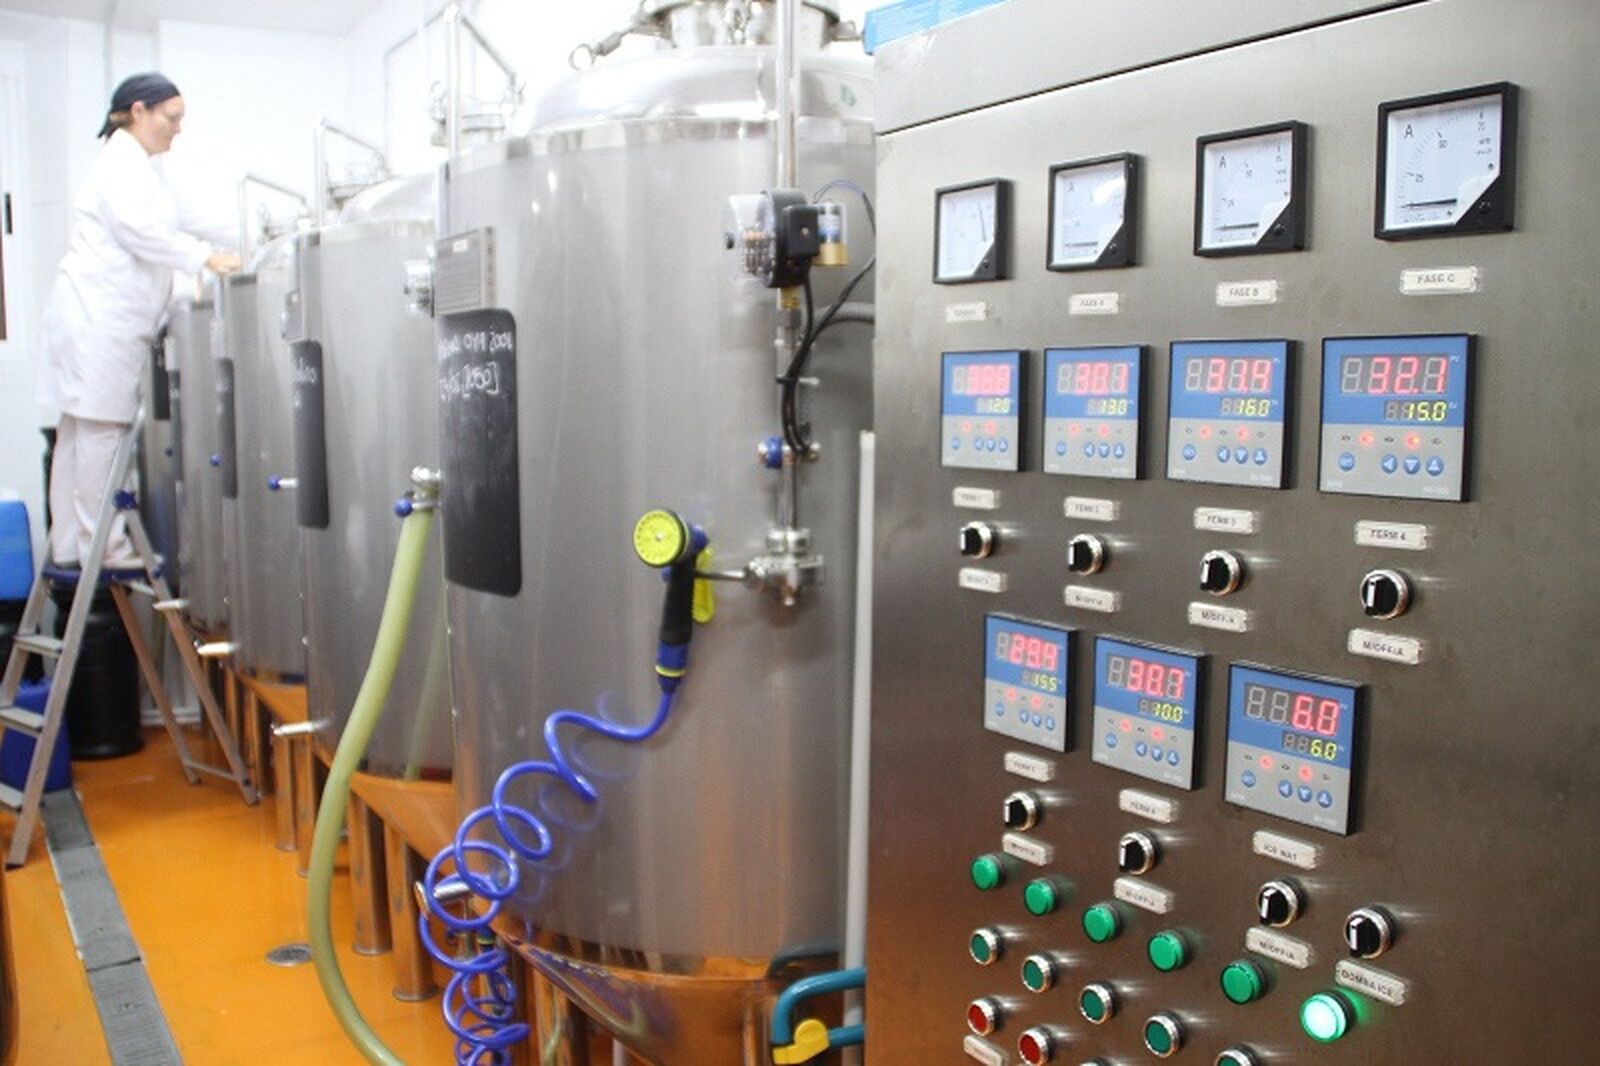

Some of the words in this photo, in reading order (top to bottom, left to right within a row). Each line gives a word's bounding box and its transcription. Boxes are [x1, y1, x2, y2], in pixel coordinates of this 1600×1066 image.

[1404, 124, 1414, 138] A
[1219, 156, 1227, 168] A
[1417, 273, 1444, 284] FASE
[1229, 288, 1250, 297] FASE
[1367, 356, 1448, 394] 32.1
[1407, 402, 1447, 420] 15.0
[1370, 528, 1398, 540] FERM
[1126, 658, 1185, 700] 30.7
[1292, 695, 1339, 735] 6.0
